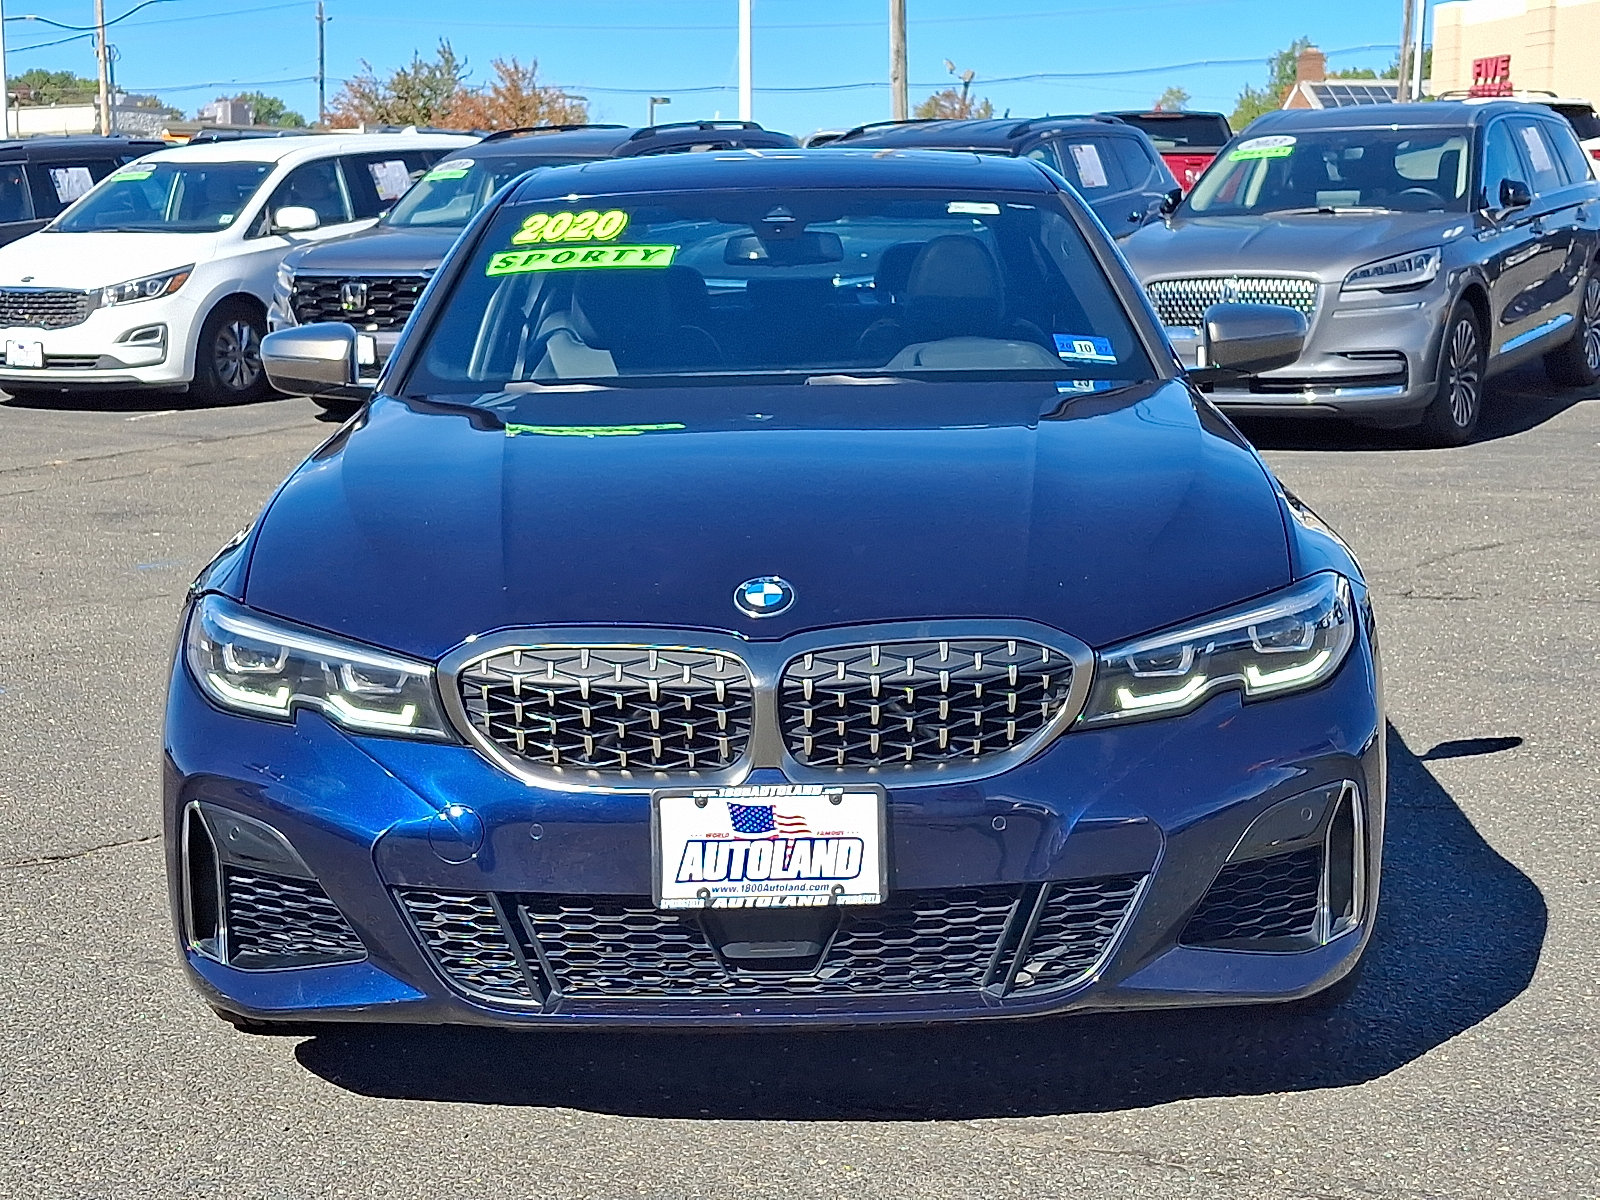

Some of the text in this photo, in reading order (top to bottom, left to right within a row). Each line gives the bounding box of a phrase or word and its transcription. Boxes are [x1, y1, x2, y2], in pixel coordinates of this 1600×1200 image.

[1473, 54, 1511, 80] FIVE
[512, 209, 631, 245] 2020
[494, 249, 665, 270] SPORTY
[1077, 343, 1092, 353] 10
[675, 837, 865, 883] AUTOLAND
[711, 883, 830, 893] www.1800Autoland.com
[711, 893, 831, 909] AUTOLAND
